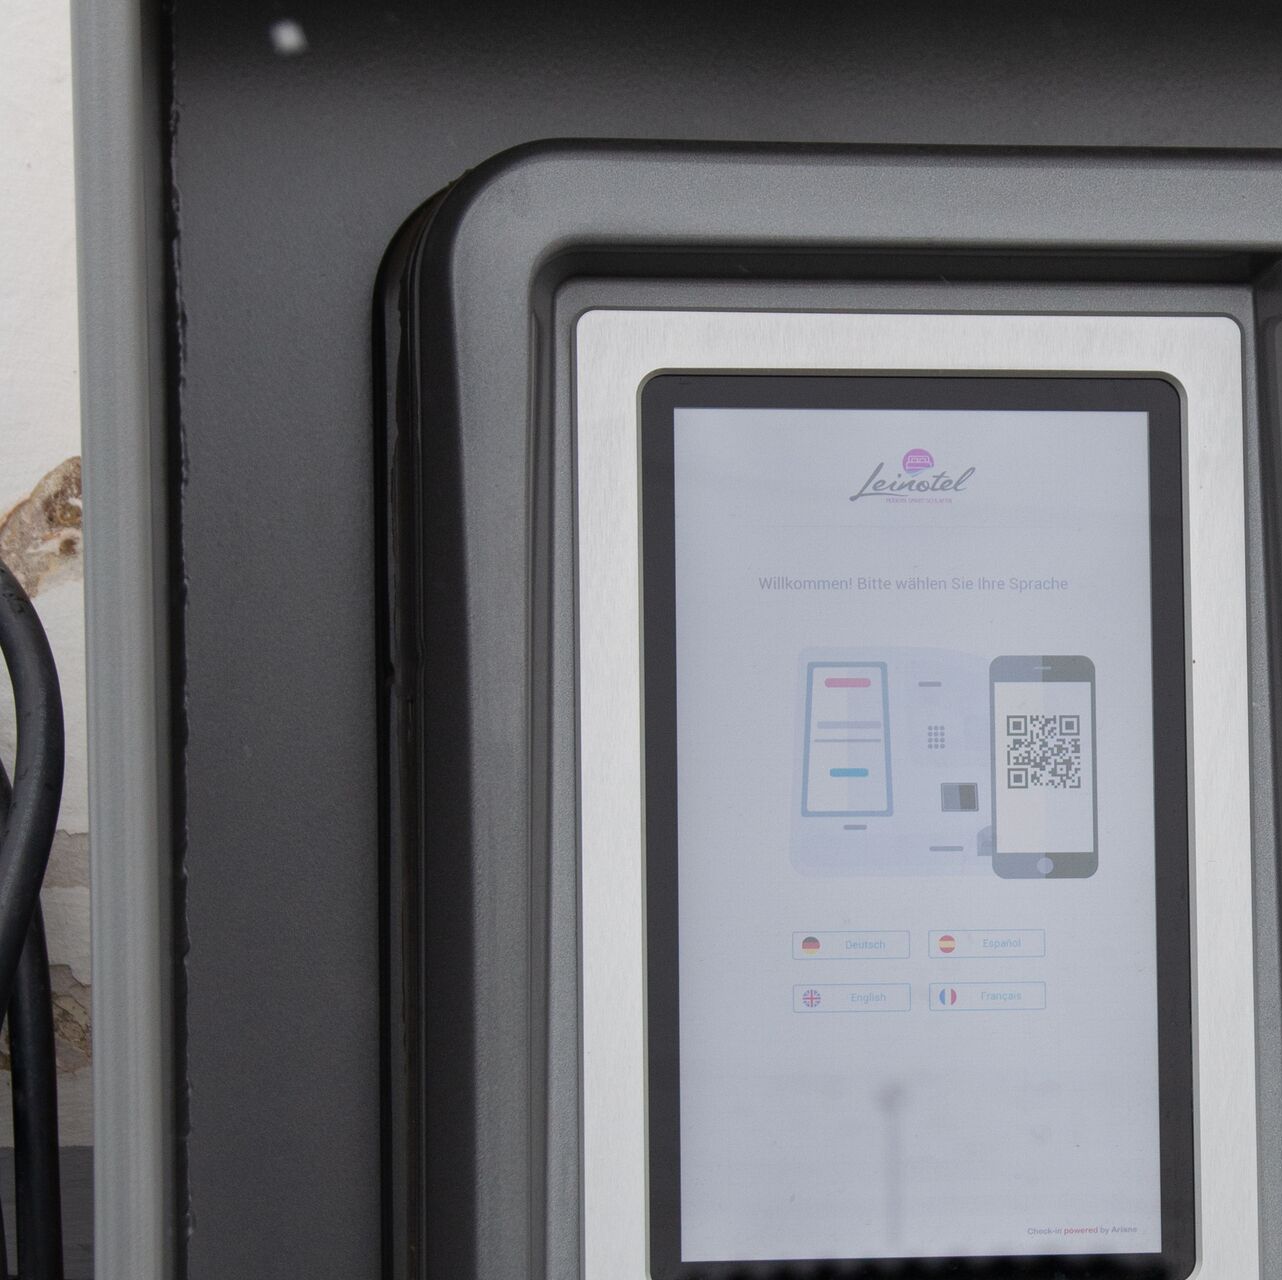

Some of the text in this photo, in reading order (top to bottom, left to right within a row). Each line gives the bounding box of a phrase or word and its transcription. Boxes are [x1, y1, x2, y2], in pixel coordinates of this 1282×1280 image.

[849, 462, 976, 502] Leinotel
[758, 576, 1068, 594] Willkommen! Bitte wählen Sie Ihre Sprache
[845, 939, 886, 950] Deutsch
[982, 938, 1022, 950] Español
[850, 992, 887, 1004] English
[980, 991, 1022, 1003] Français
[1027, 1227, 1062, 1235] Check-in
[1063, 1226, 1098, 1236] powered
[1100, 1226, 1109, 1235] by
